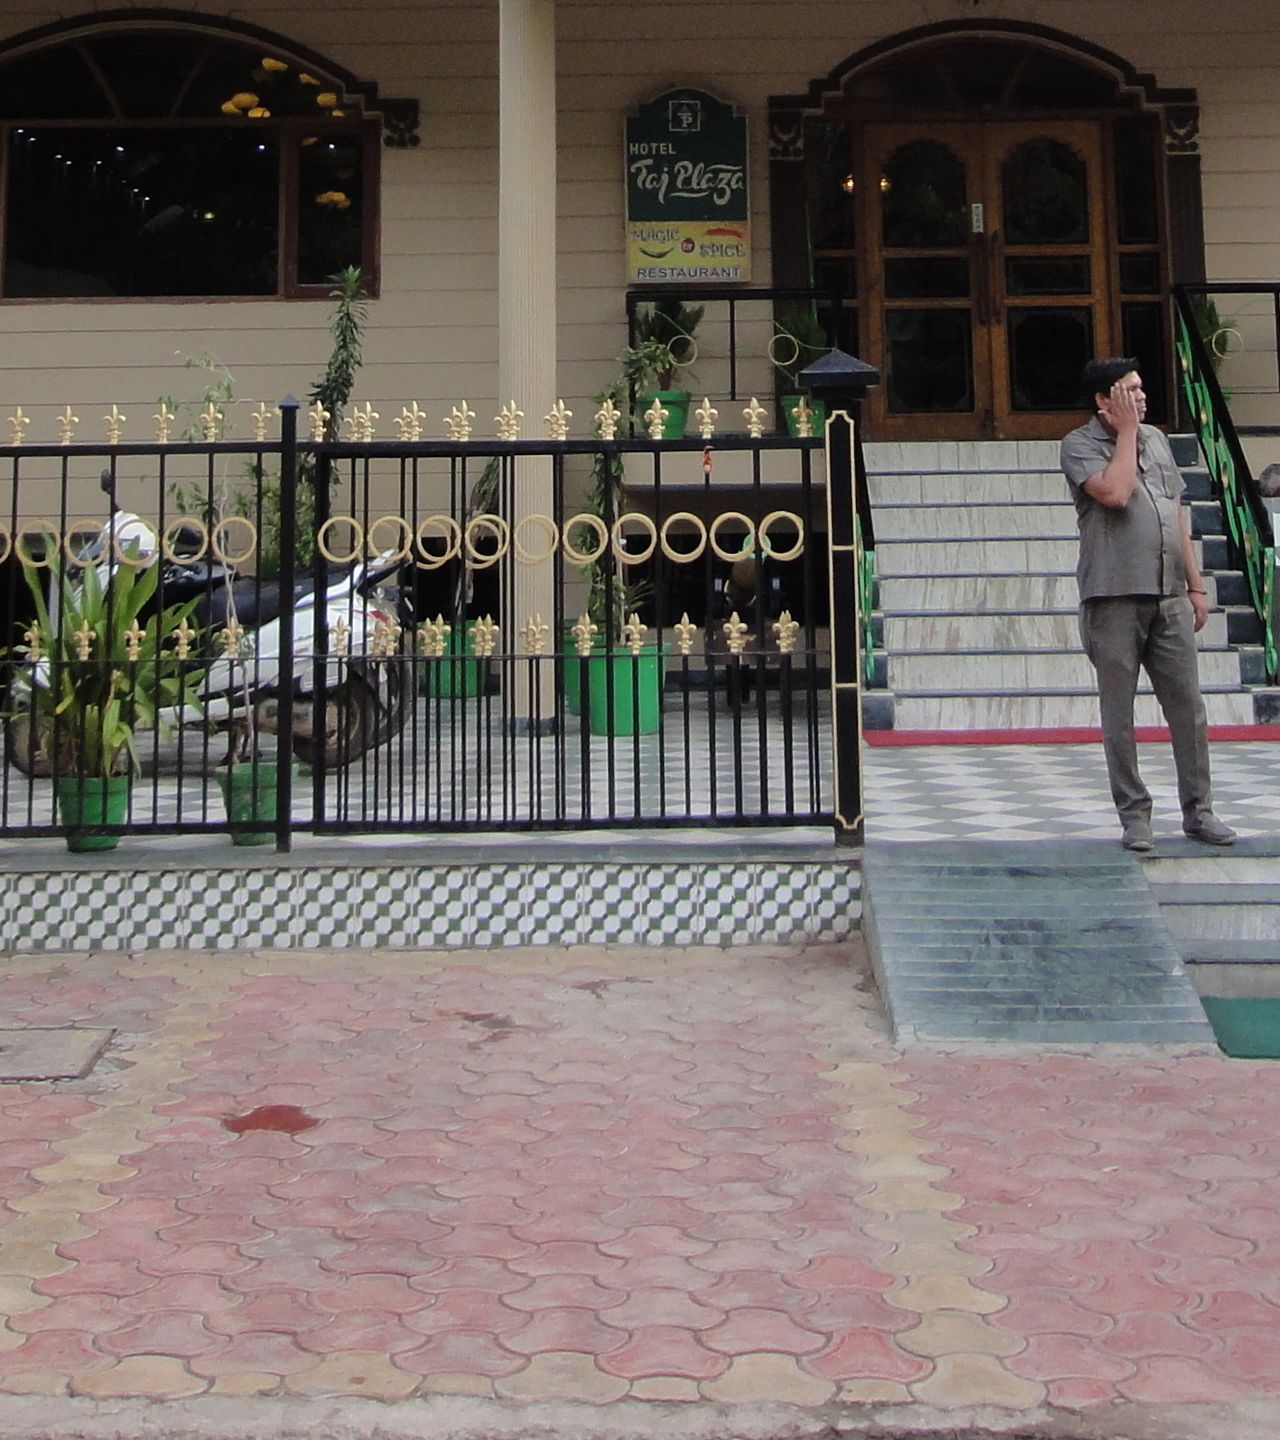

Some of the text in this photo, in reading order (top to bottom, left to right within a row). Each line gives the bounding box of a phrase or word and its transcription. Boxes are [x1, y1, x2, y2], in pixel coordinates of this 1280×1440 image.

[629, 142, 676, 156] HOTEL
[629, 158, 745, 206] Taj Plaza
[637, 267, 741, 279] RESTAURANT
